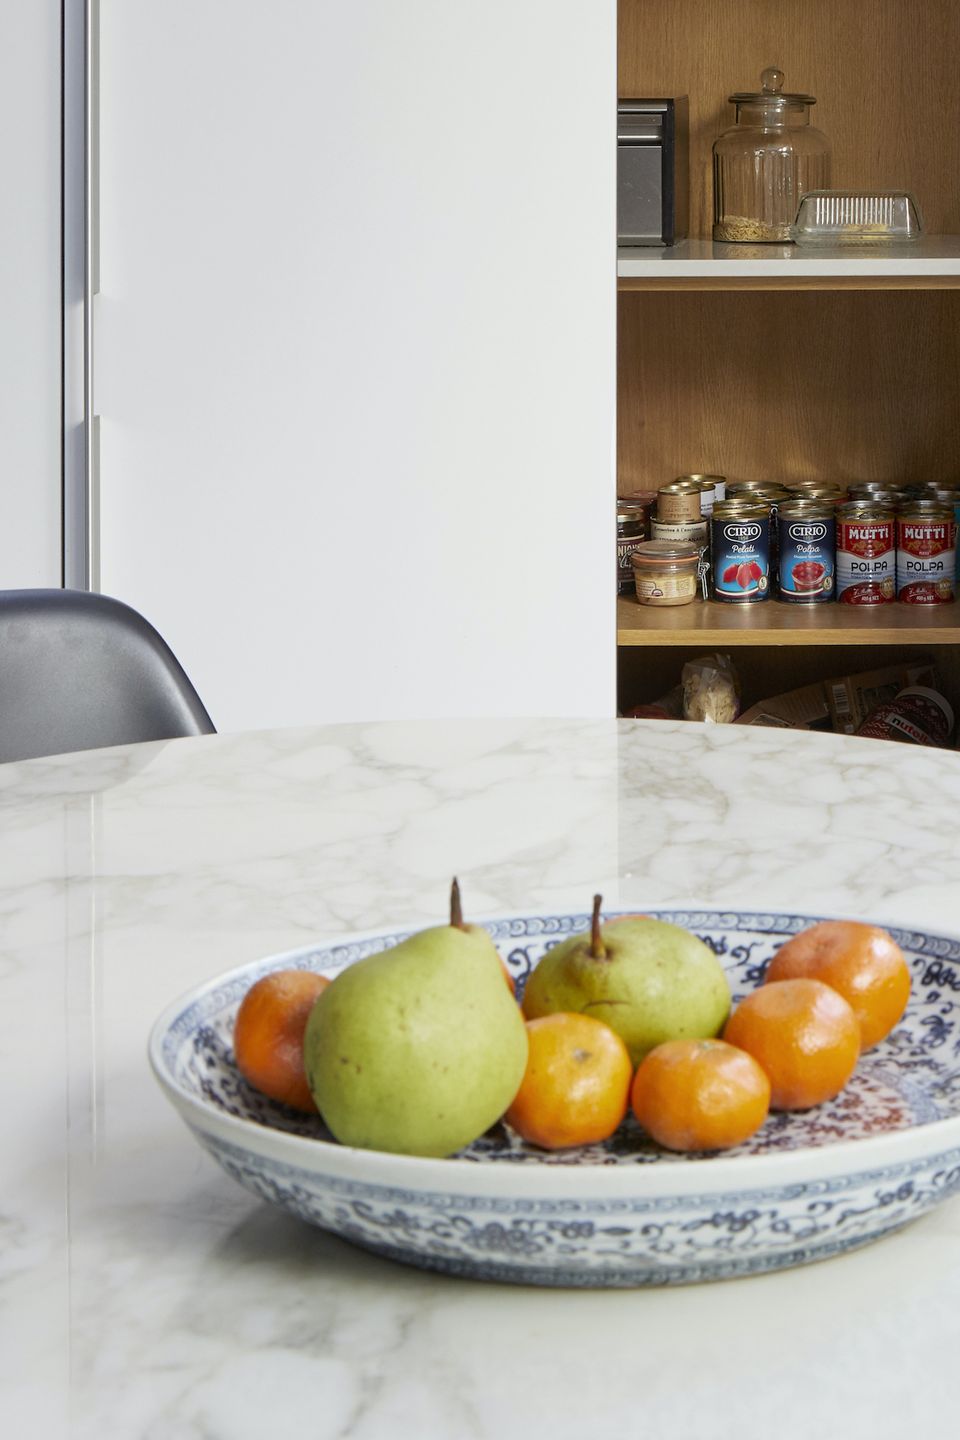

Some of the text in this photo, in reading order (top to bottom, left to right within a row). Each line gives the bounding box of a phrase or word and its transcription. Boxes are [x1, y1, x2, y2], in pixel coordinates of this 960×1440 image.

[727, 526, 758, 537] CIRIO
[792, 526, 823, 536] CIRIO
[849, 528, 889, 540] MUTTI
[905, 527, 945, 540] MUTTI
[796, 544, 820, 555] Polpa
[906, 561, 944, 572] POLPA
